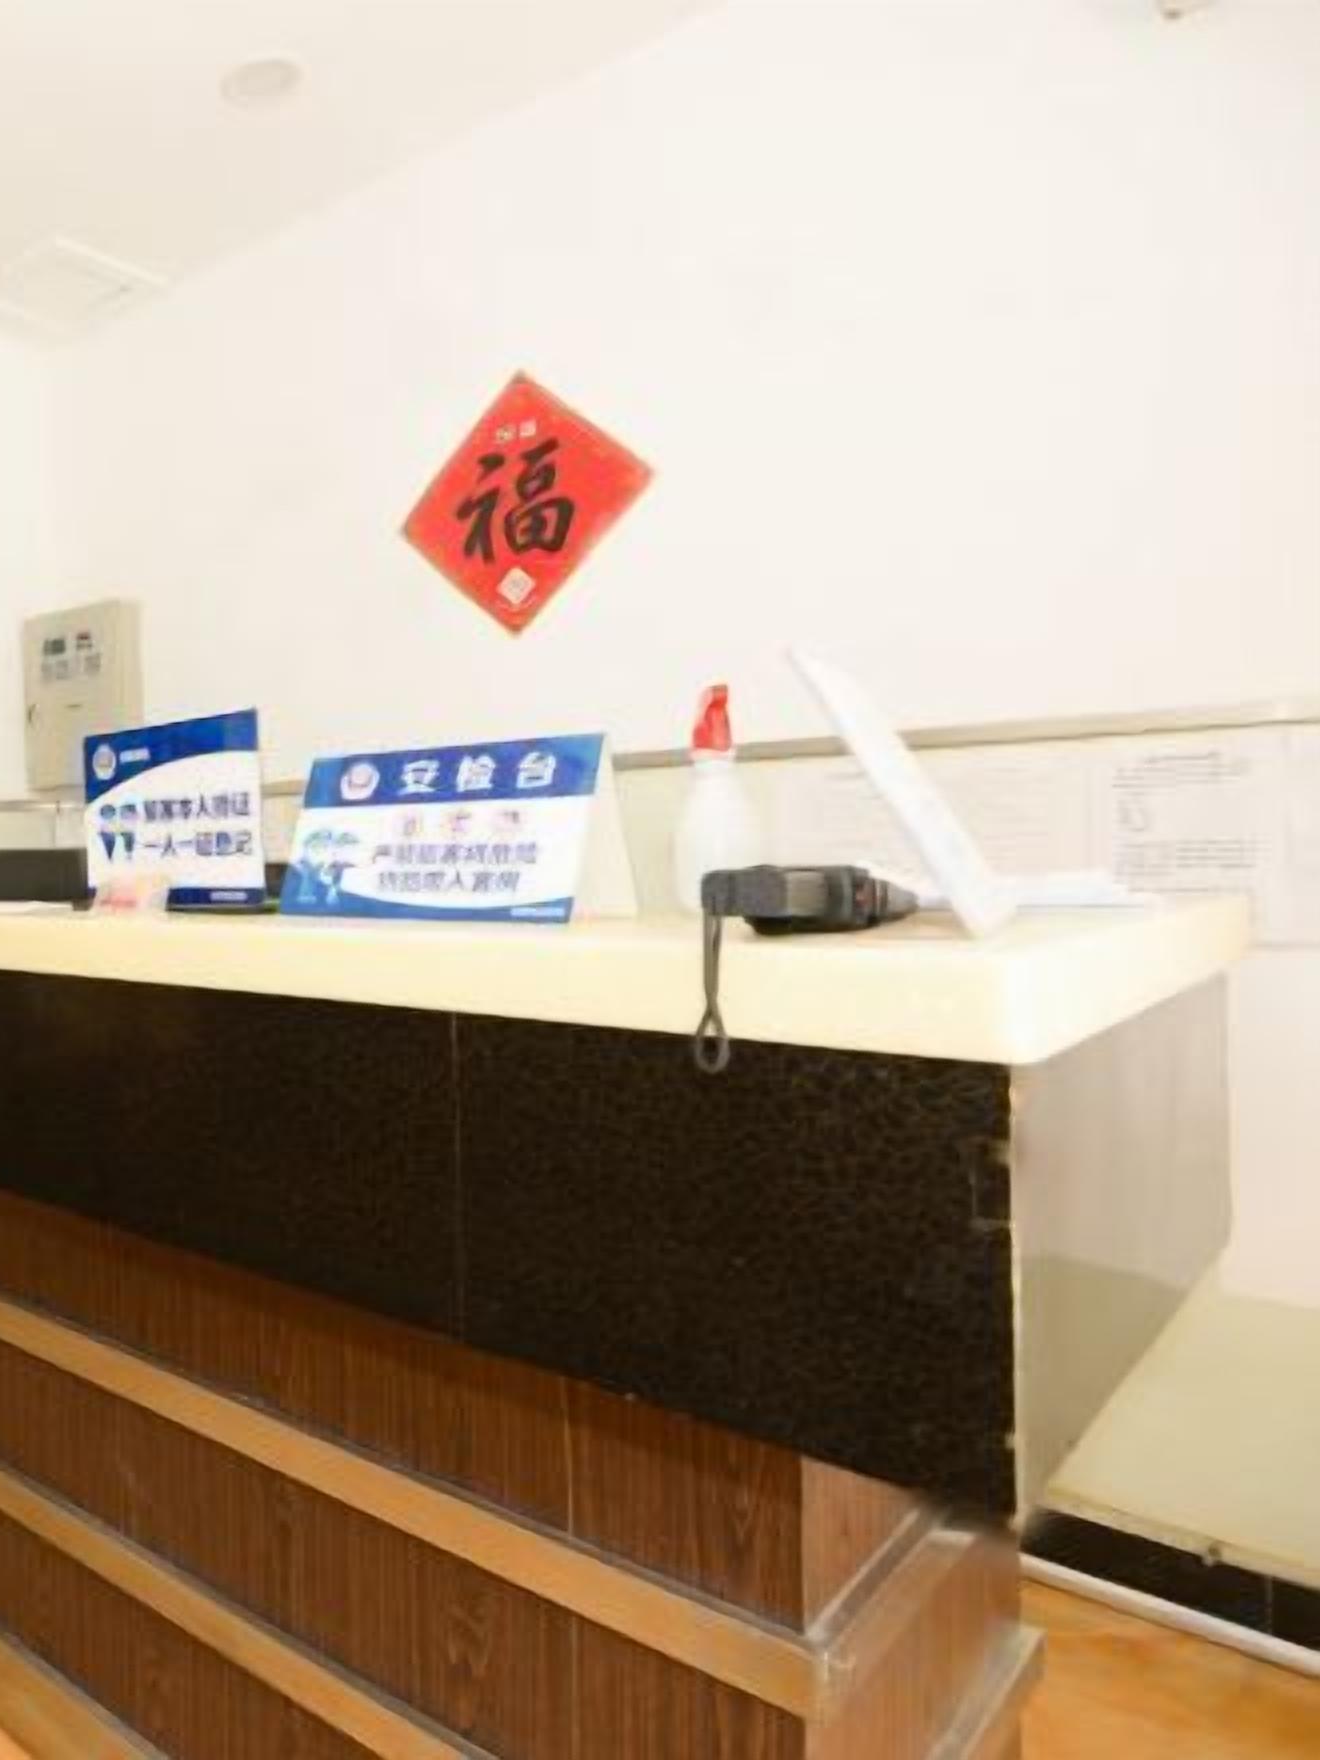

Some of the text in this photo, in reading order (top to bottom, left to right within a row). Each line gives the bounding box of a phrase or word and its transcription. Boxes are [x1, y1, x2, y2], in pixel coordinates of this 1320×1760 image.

[456, 438, 575, 565] 福
[397, 751, 556, 794] 安检台
